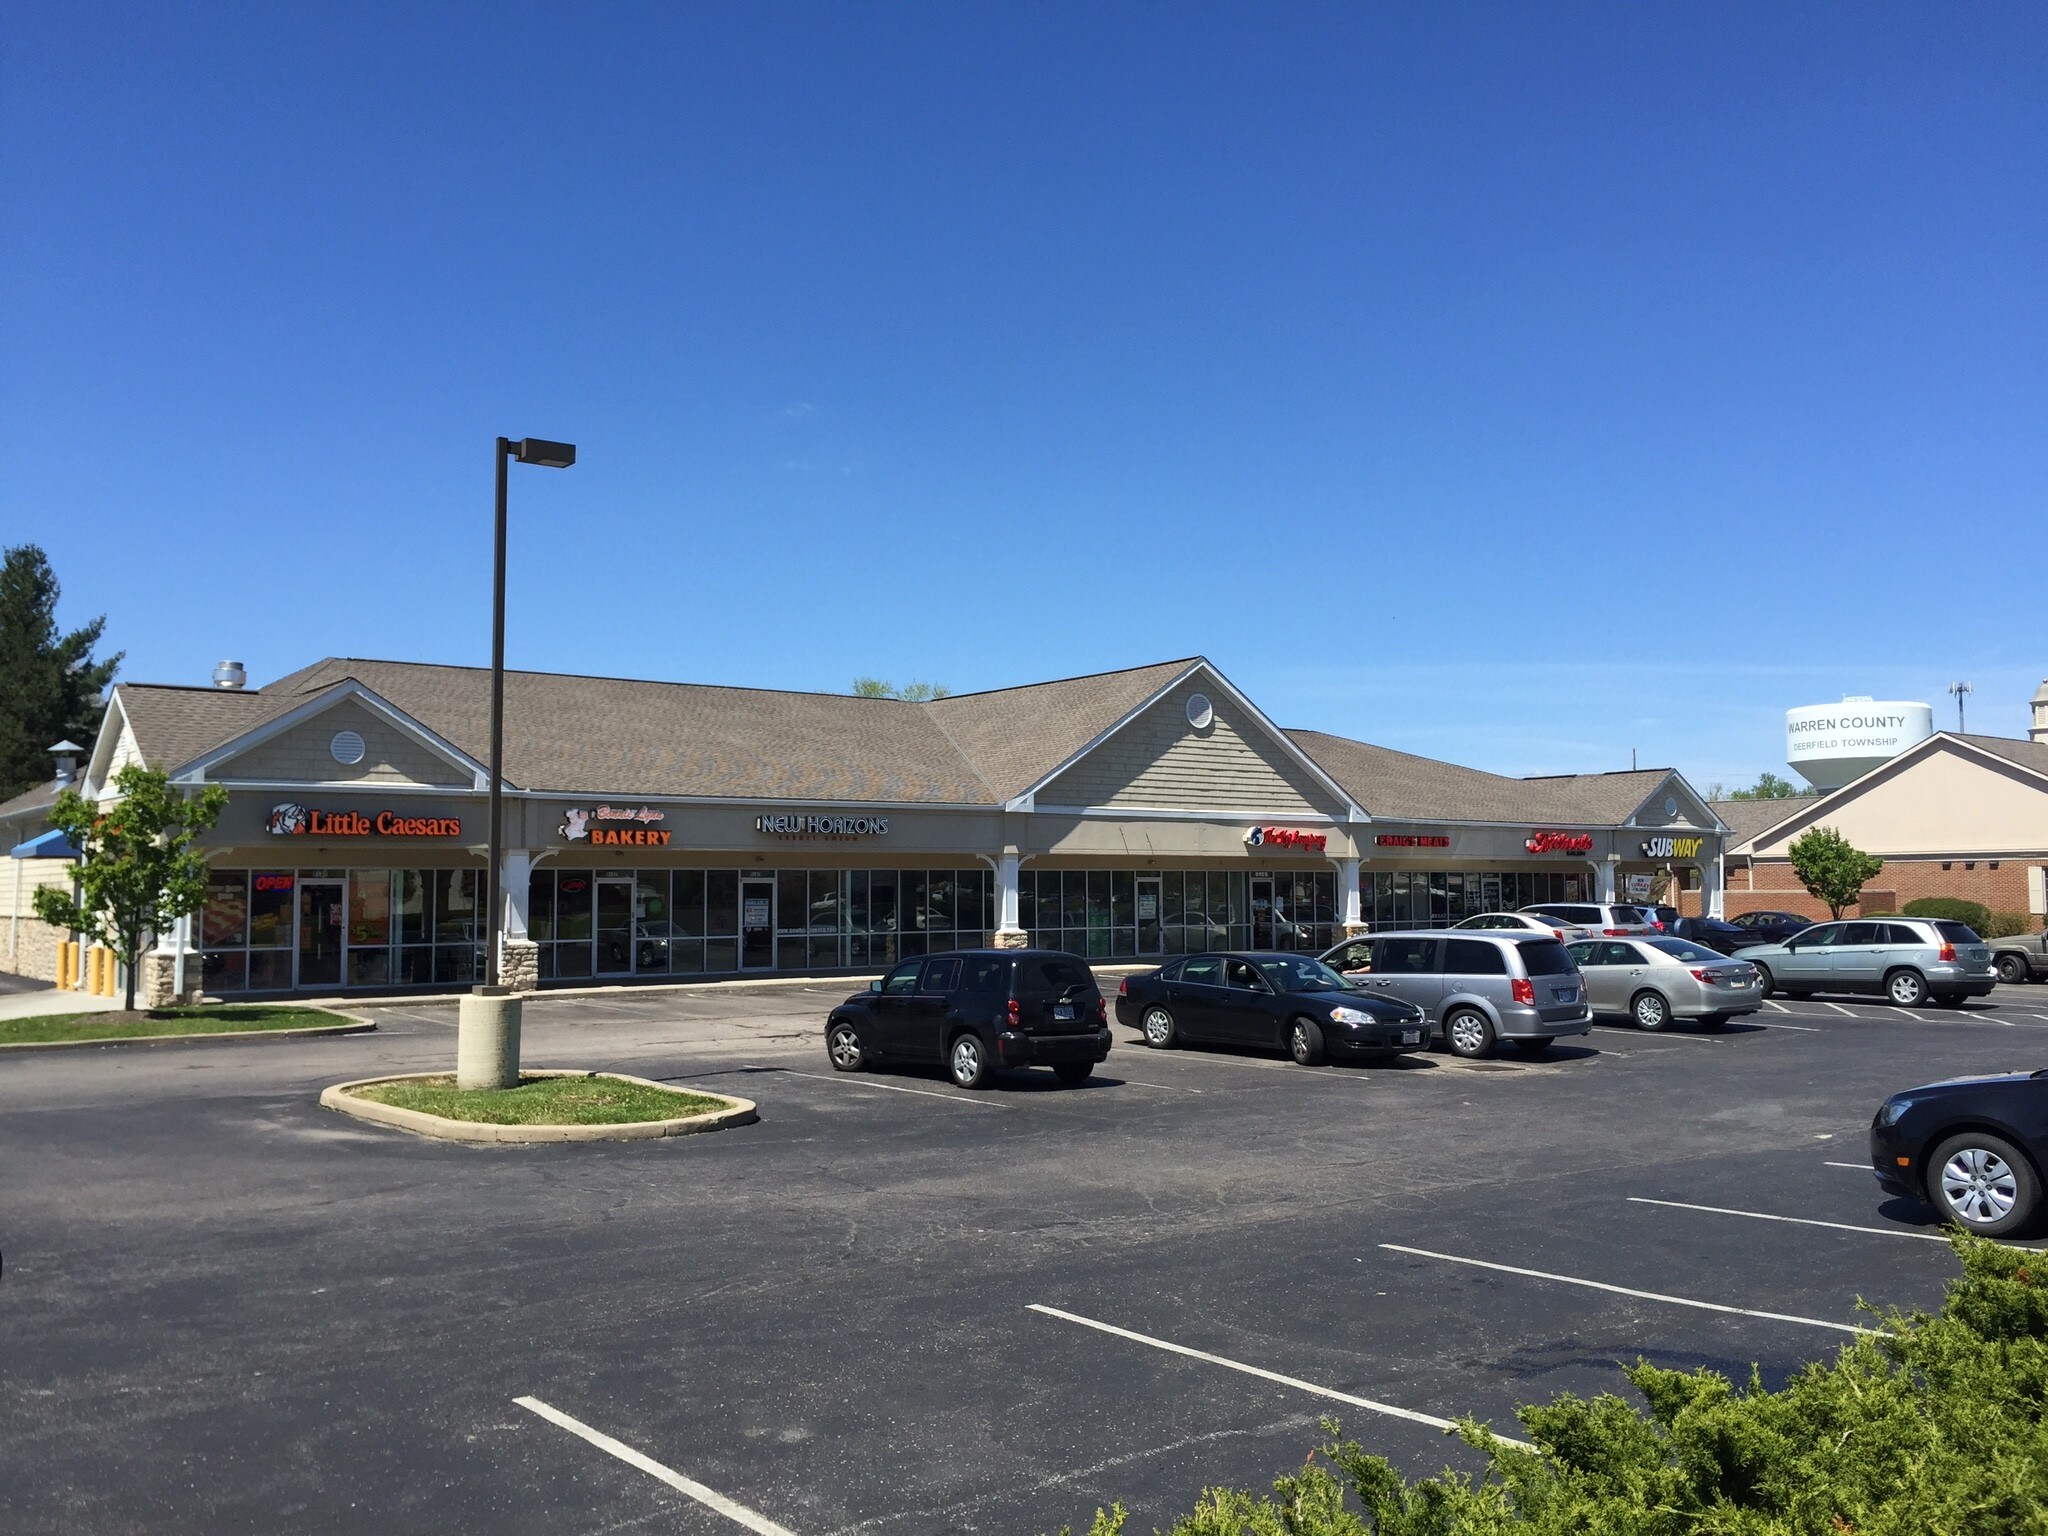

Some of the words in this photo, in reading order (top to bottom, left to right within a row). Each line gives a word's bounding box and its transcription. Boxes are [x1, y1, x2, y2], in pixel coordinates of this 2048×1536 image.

[1788, 719, 1836, 734] WARREN
[1840, 716, 1905, 729] COUNTY
[1793, 739, 1838, 751] DEERFIELD
[1842, 737, 1898, 748] TOWNSHIP
[309, 809, 370, 835] Little
[376, 810, 461, 836] Caesars
[762, 816, 802, 833] NEW
[807, 816, 889, 834] HORIZONS
[591, 829, 672, 845] BAKERY
[1419, 836, 1450, 847] MEATS
[1646, 837, 1704, 858] SUBWAY
[255, 876, 294, 892] OPEN
